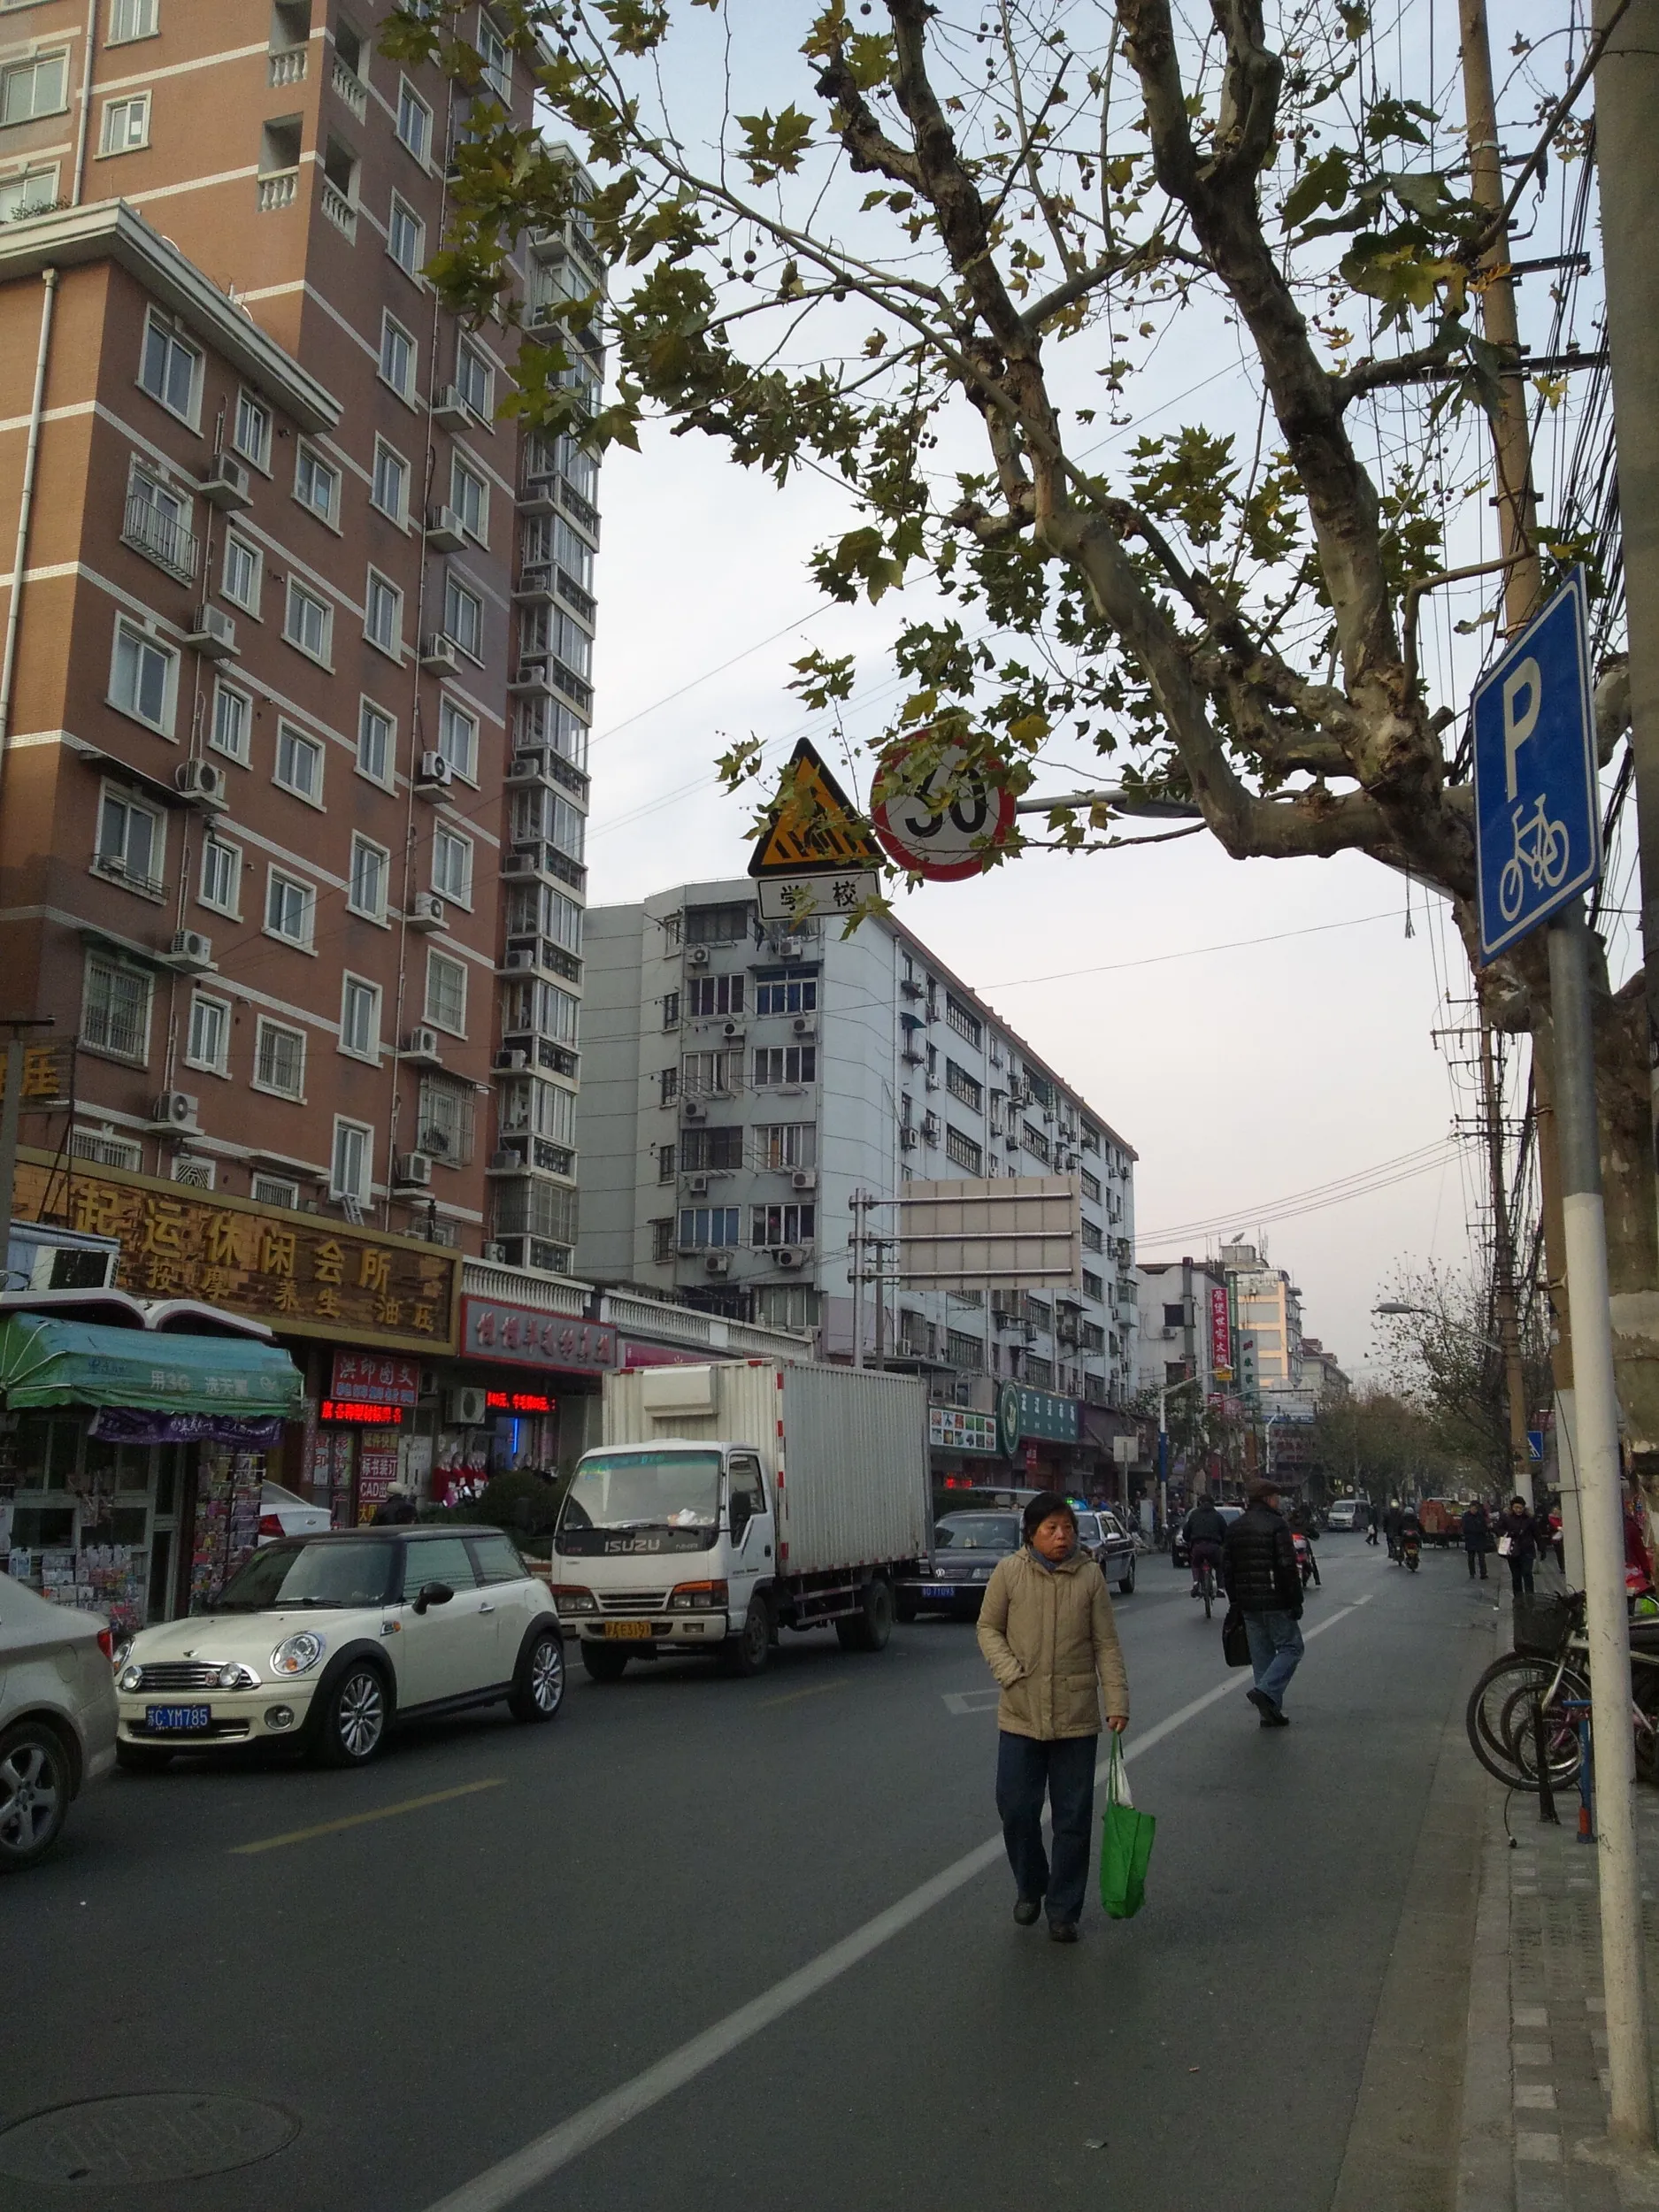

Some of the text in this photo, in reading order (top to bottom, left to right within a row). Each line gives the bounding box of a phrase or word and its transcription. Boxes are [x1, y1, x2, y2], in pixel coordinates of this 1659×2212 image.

[1502, 657, 1541, 803] P
[902, 766, 987, 838] 30
[146, 1255, 230, 1302] 按摩
[373, 1295, 434, 1332] 油压
[361, 1456, 397, 1478] 标书装订
[604, 1540, 660, 1553] ISUZU
